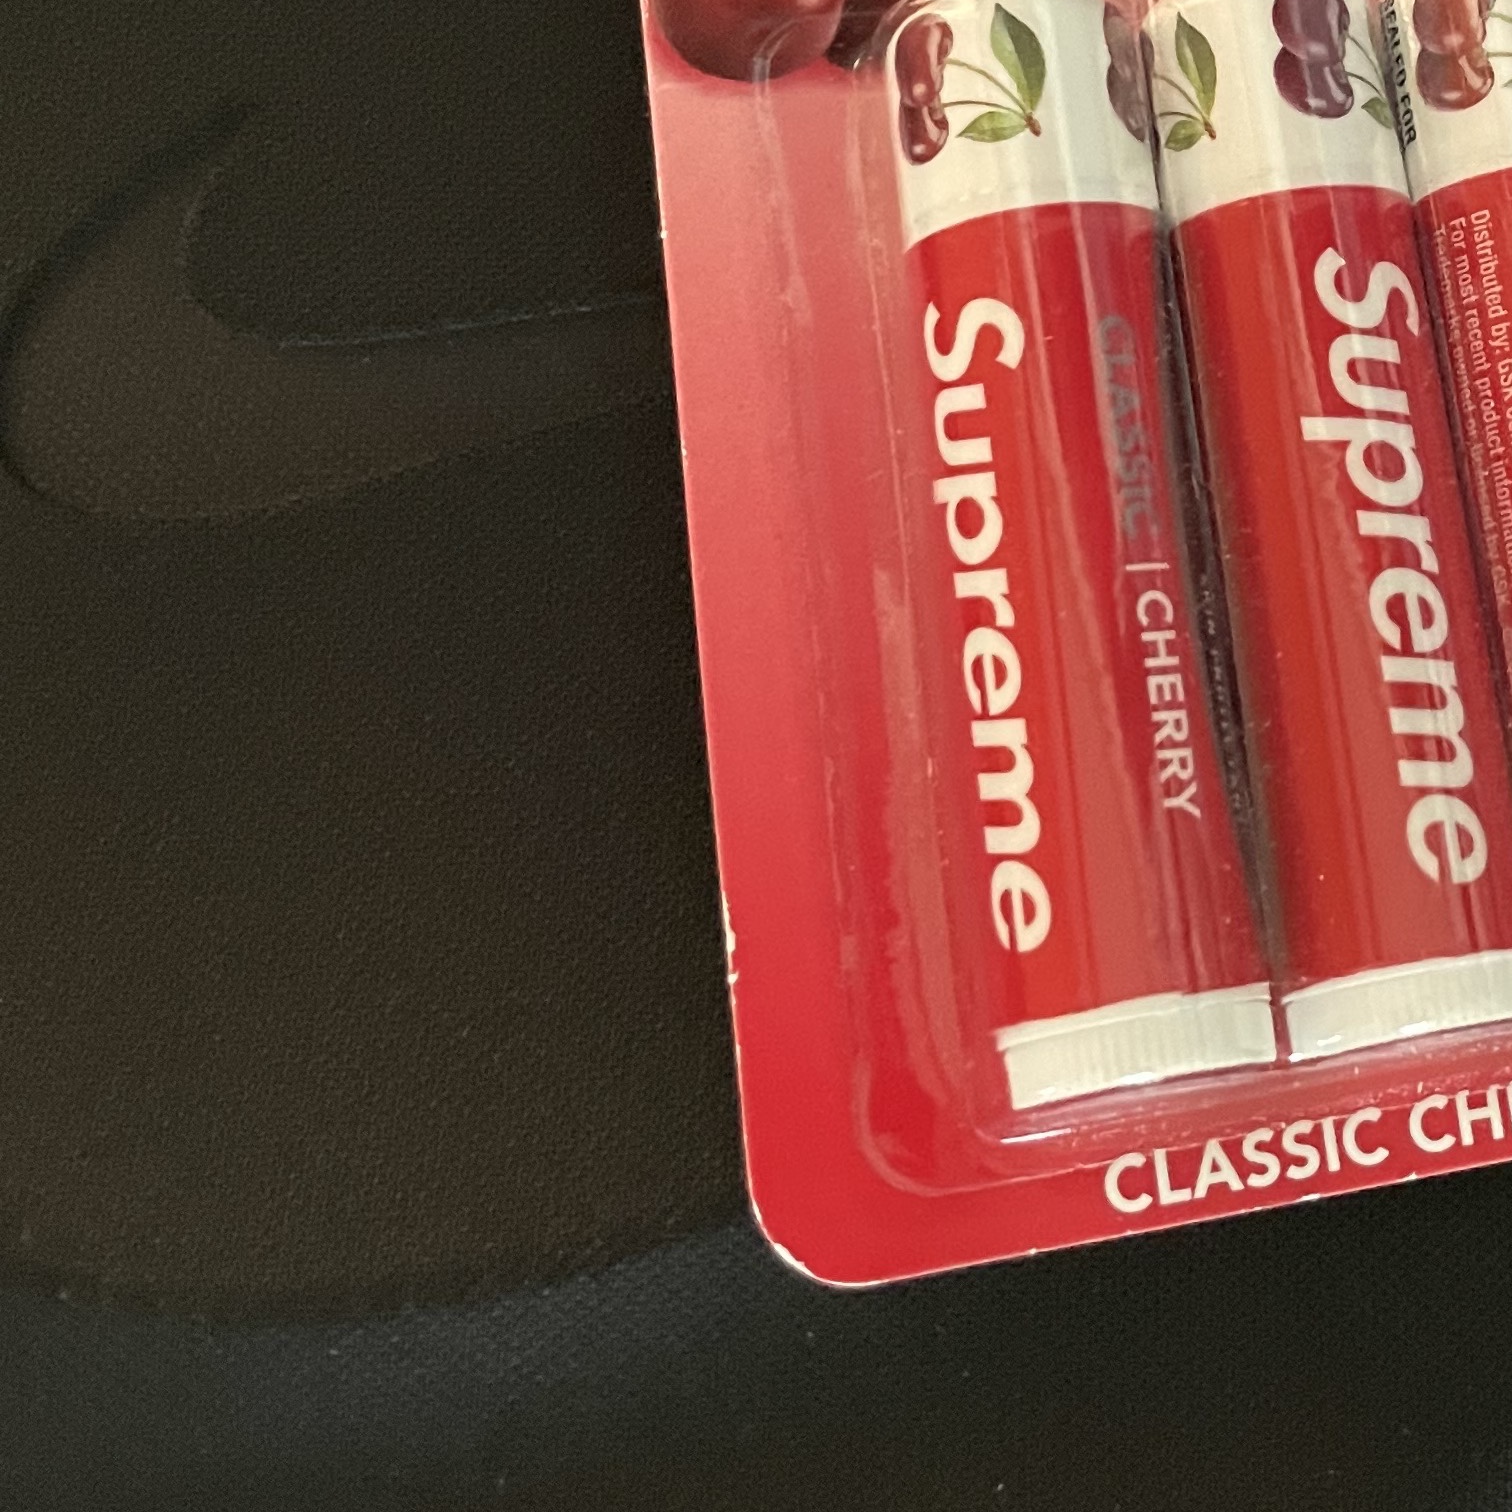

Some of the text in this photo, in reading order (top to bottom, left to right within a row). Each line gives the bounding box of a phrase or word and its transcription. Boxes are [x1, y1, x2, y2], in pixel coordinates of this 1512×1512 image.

[1400, 92, 1417, 145] FOR
[1449, 217, 1466, 249] For
[1470, 209, 1508, 318] Distributed
[1454, 256, 1479, 305] most
[1464, 306, 1492, 375] recent
[1488, 322, 1511, 355] by:
[1473, 377, 1507, 457] product
[1100, 314, 1201, 819] CLASSIC CHERRY
[1300, 246, 1489, 885] Supreme
[923, 297, 1053, 953] Supreme
[1103, 1106, 1390, 1213] CLASSIC
